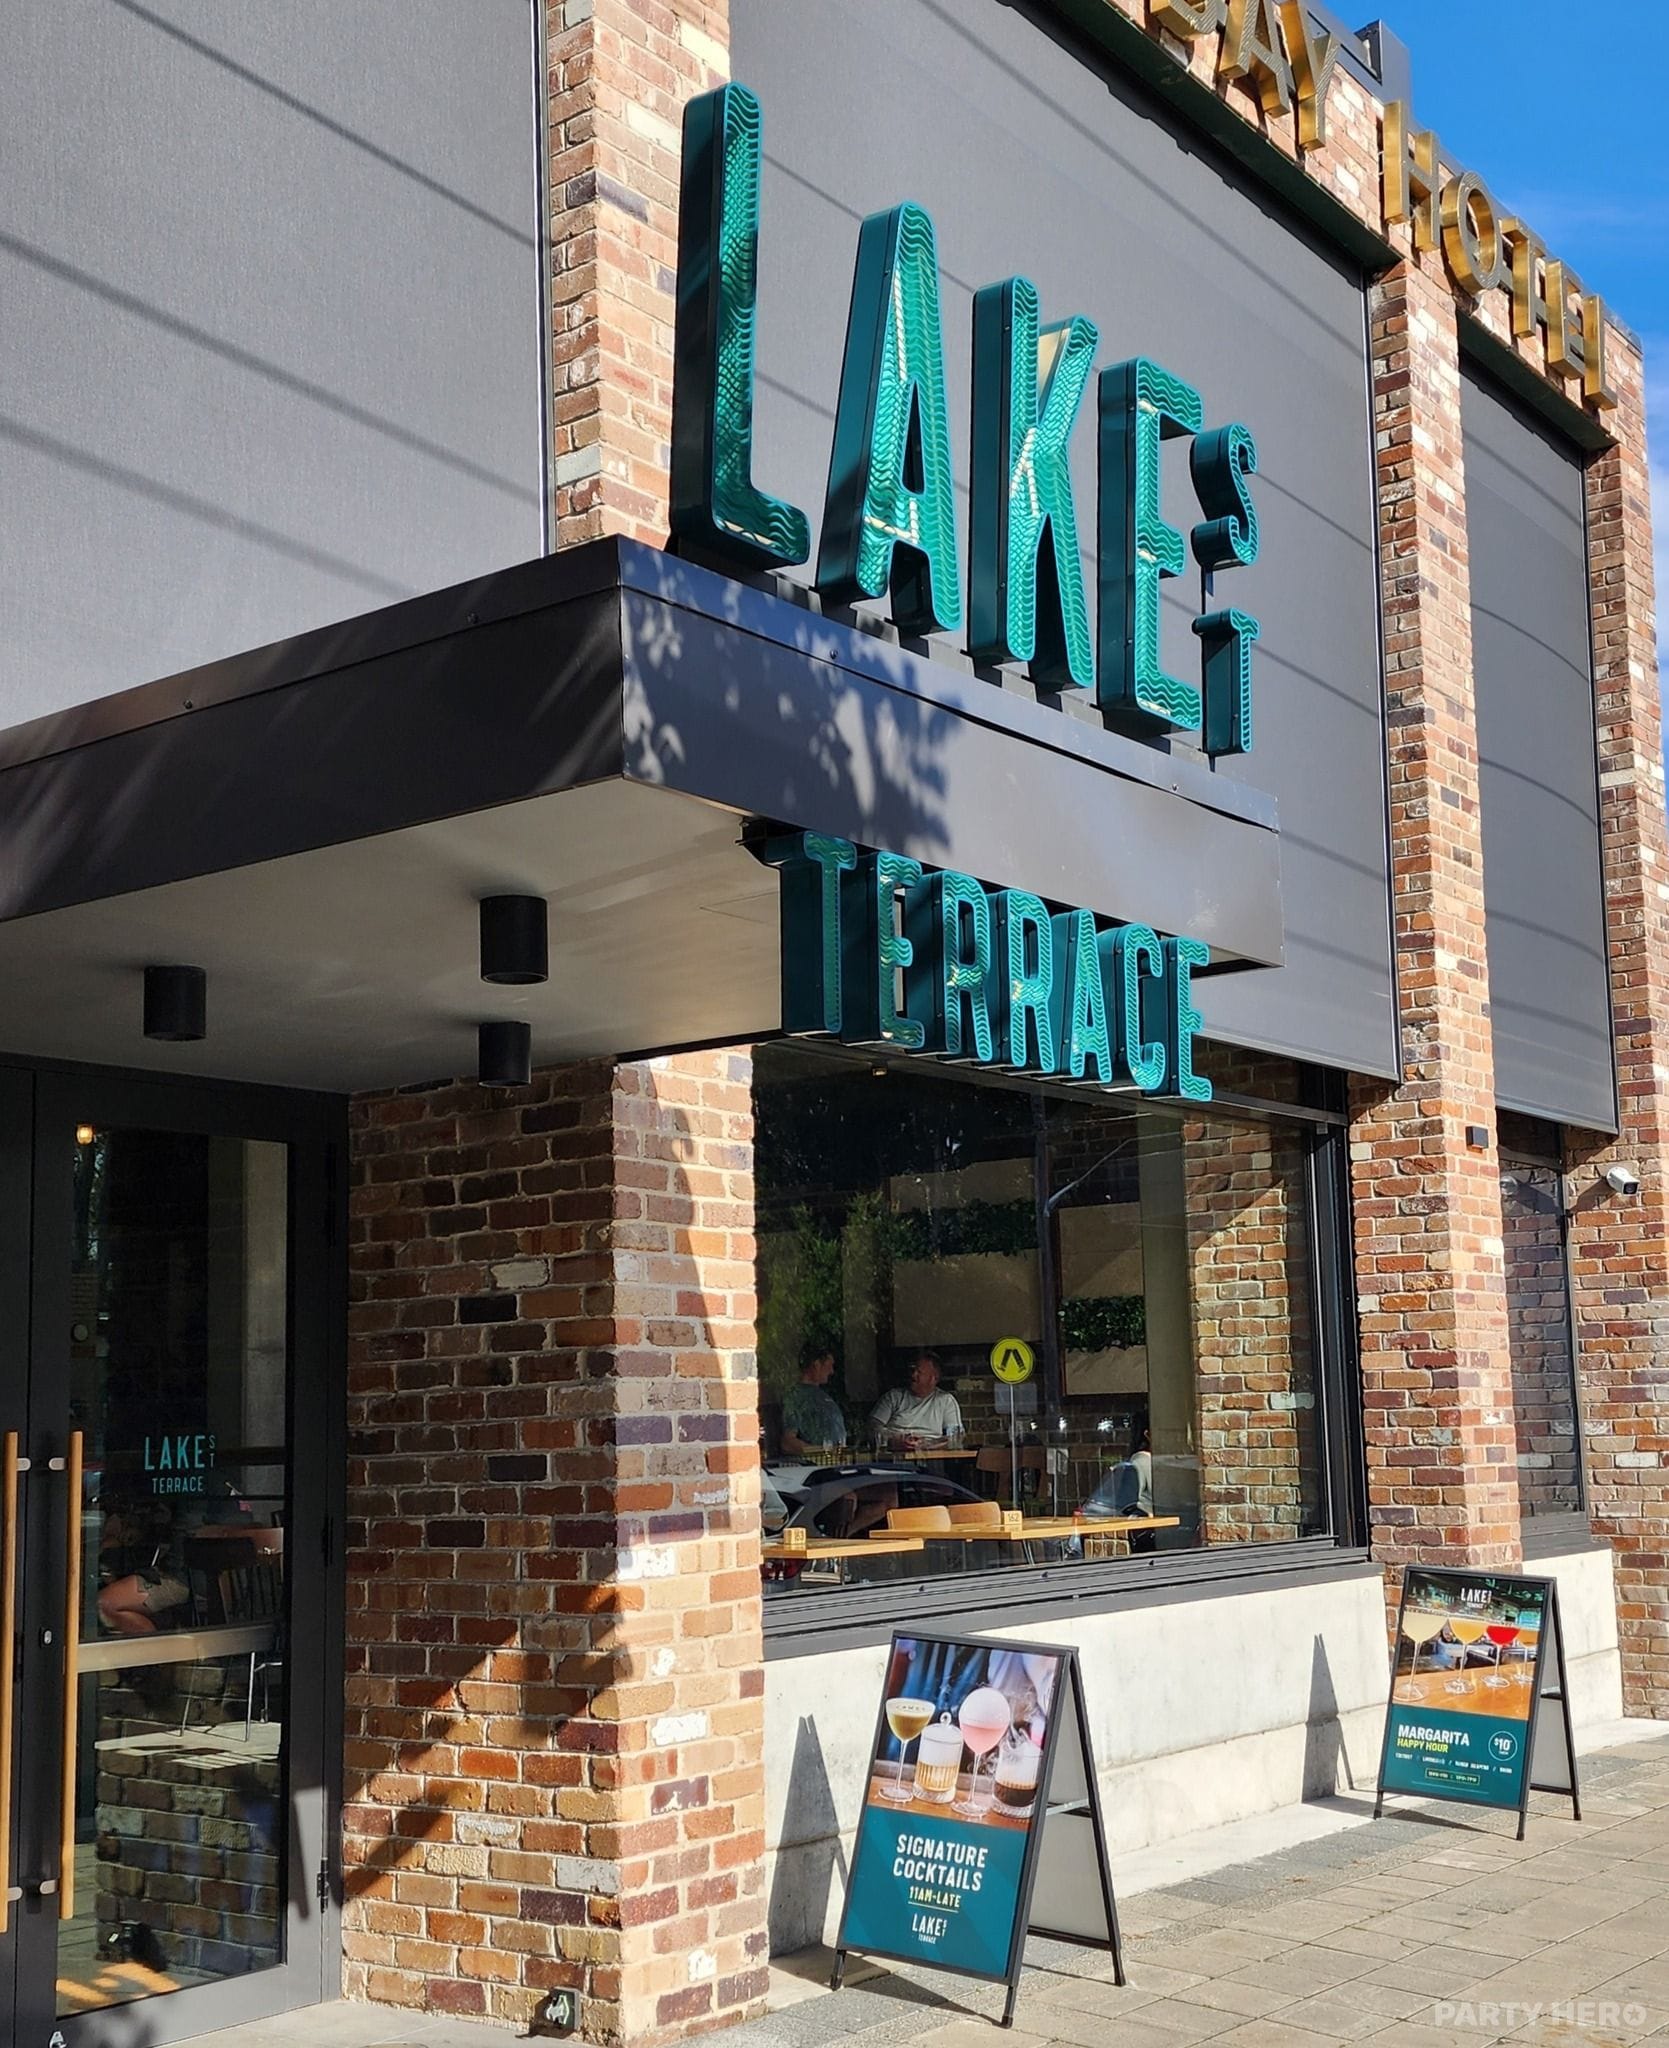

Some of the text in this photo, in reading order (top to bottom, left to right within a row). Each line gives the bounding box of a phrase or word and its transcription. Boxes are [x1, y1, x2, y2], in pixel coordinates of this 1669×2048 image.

[1147, 0, 1617, 410] AY HOTEL
[671, 81, 1203, 730] LAKE
[780, 830, 1214, 1102] TERRACE
[144, 1434, 206, 1470] LAKE
[152, 1476, 204, 1494] TERRACE
[1396, 1738, 1449, 1753] HAPPY HOUR
[1398, 1724, 1470, 1747] MARGARITA
[896, 1833, 988, 1868] SIGNATURE
[893, 1857, 983, 1891] COCKTAILS
[909, 1885, 961, 1908] 11AM-LATE
[912, 1913, 943, 1937] LAKE
